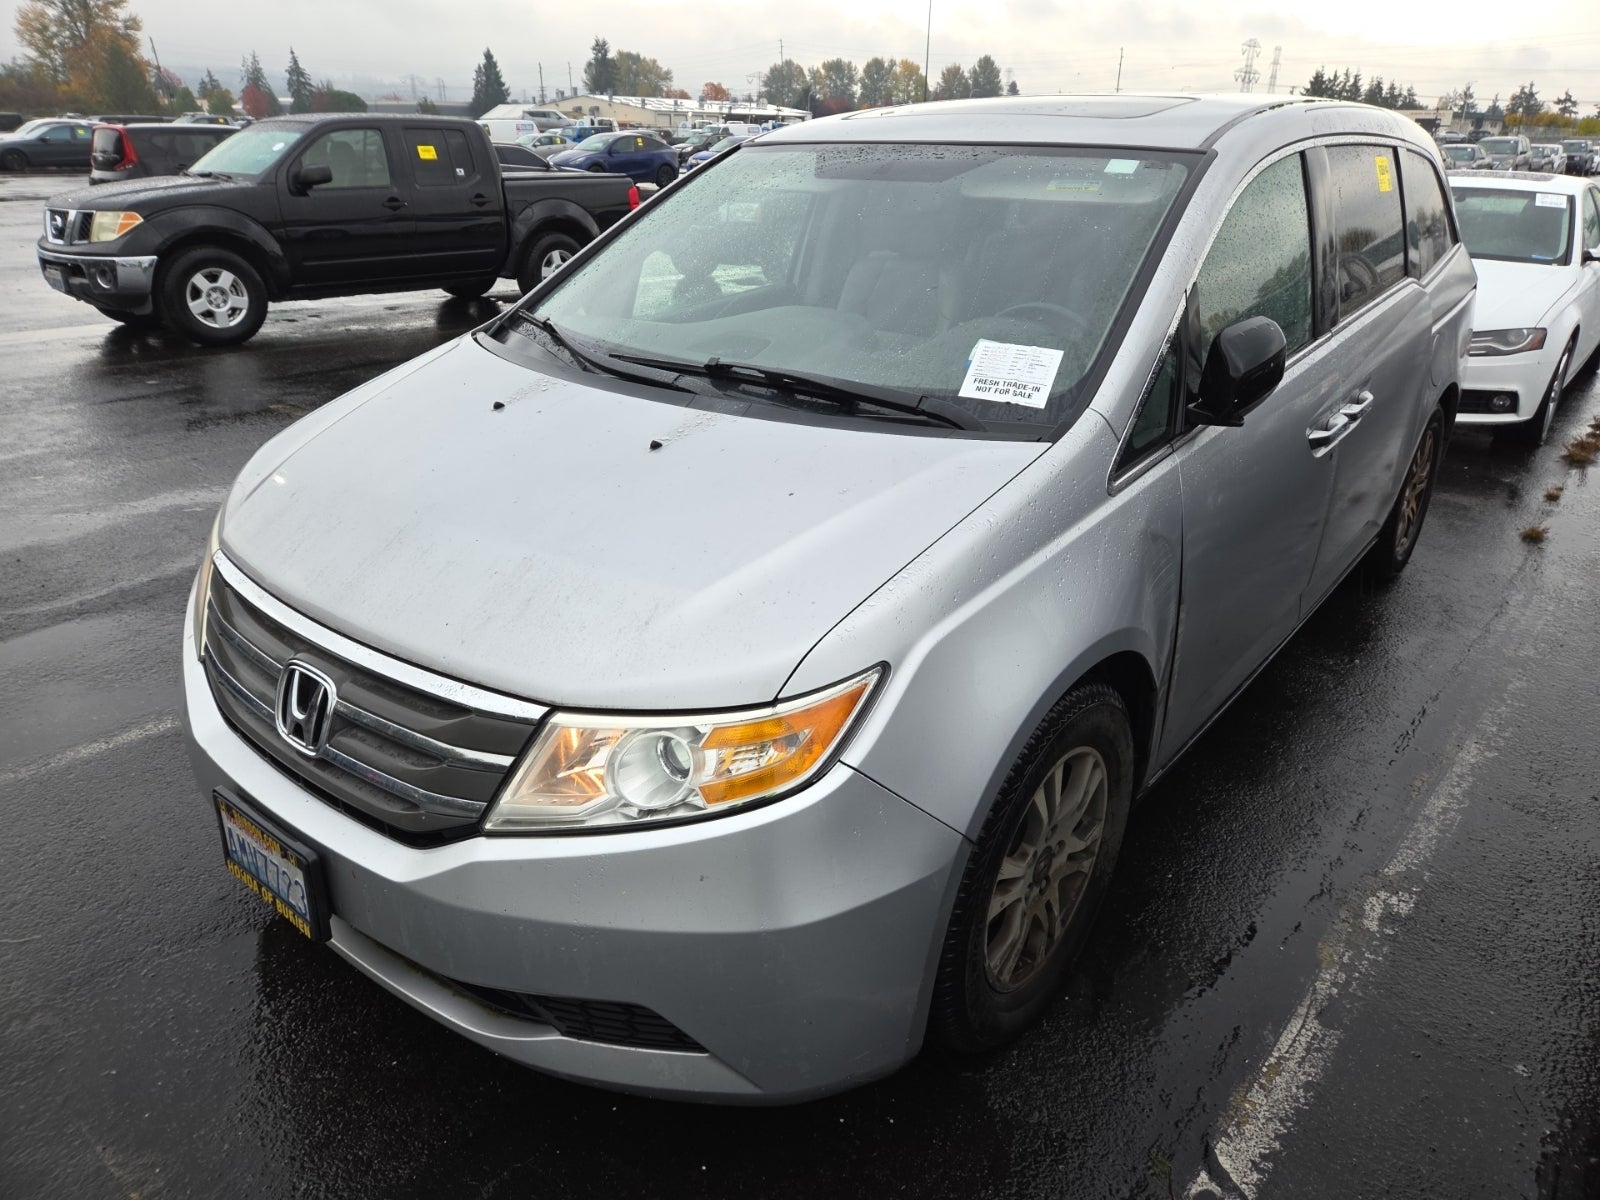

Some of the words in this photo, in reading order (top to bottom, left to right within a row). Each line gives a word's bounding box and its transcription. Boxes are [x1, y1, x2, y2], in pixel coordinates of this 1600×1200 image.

[973, 377, 1000, 387] FRESH
[1002, 380, 1041, 393] TRADE-IN
[975, 385, 993, 394] NOT
[994, 387, 1010, 396] FOR
[1012, 389, 1033, 399] SALE
[227, 859, 260, 894] HONDA
[261, 886, 274, 905] OF
[276, 903, 311, 939] BURIEN
